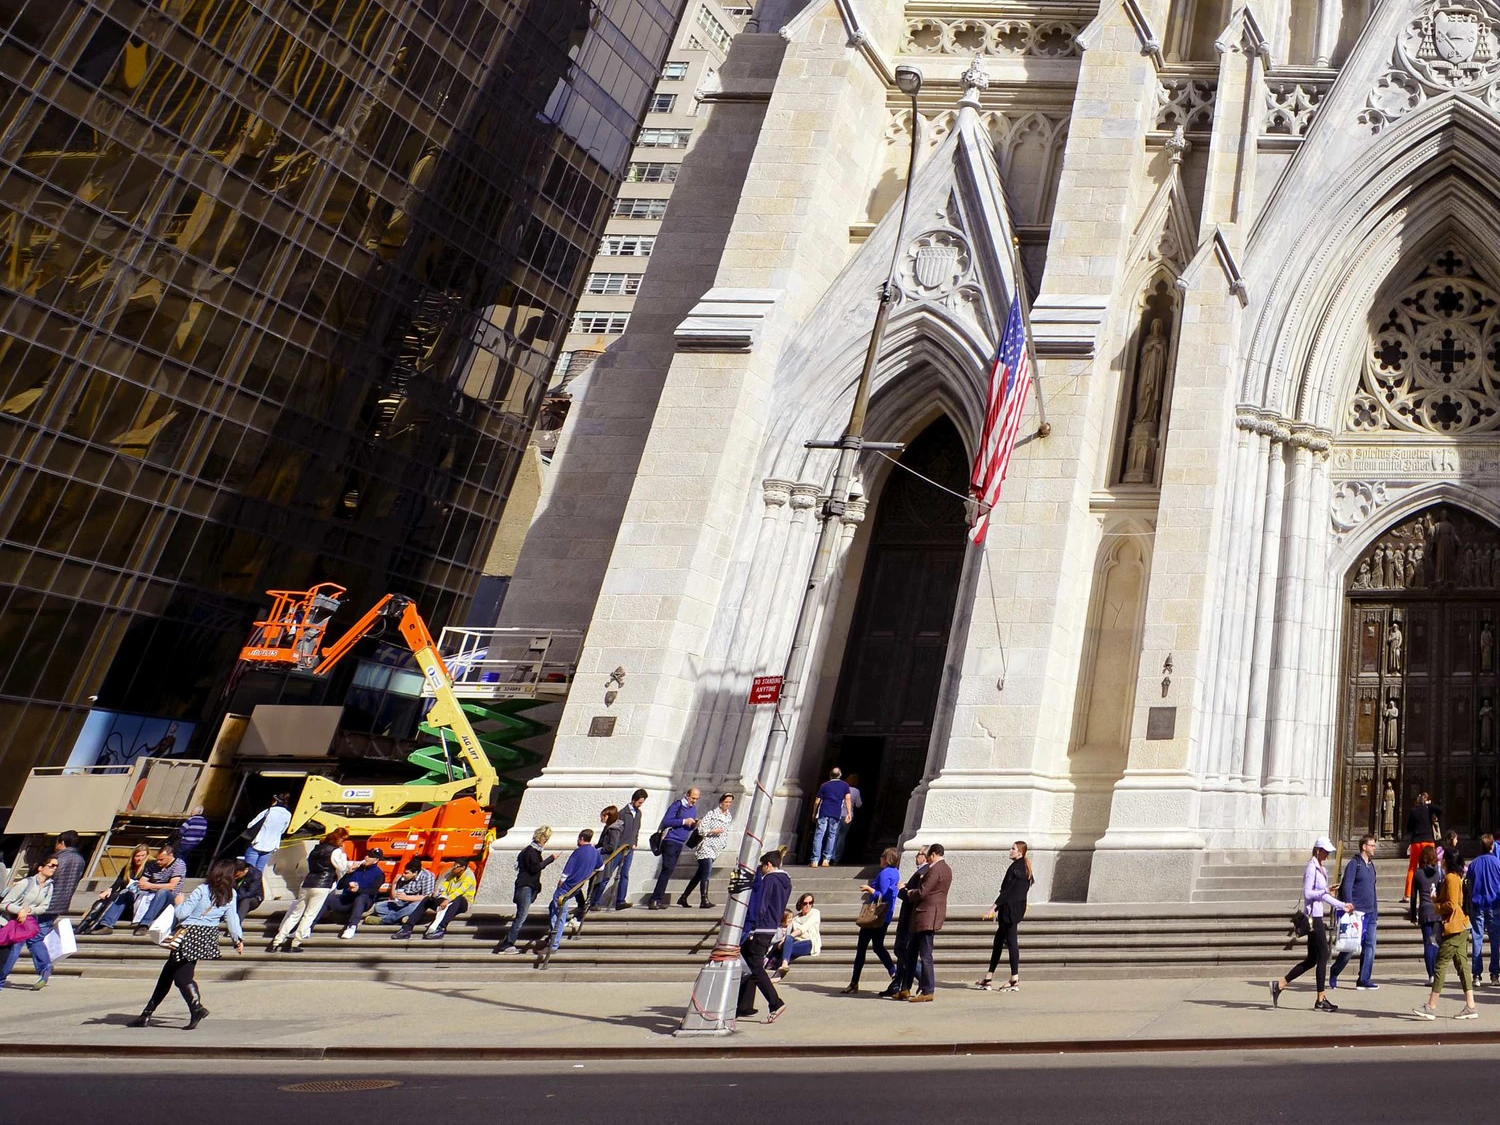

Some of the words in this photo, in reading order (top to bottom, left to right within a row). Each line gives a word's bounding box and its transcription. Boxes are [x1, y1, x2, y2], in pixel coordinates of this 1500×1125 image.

[756, 685, 777, 693] ANYTIME
[461, 735, 471, 746] JLG
[468, 747, 479, 760] LIFT
